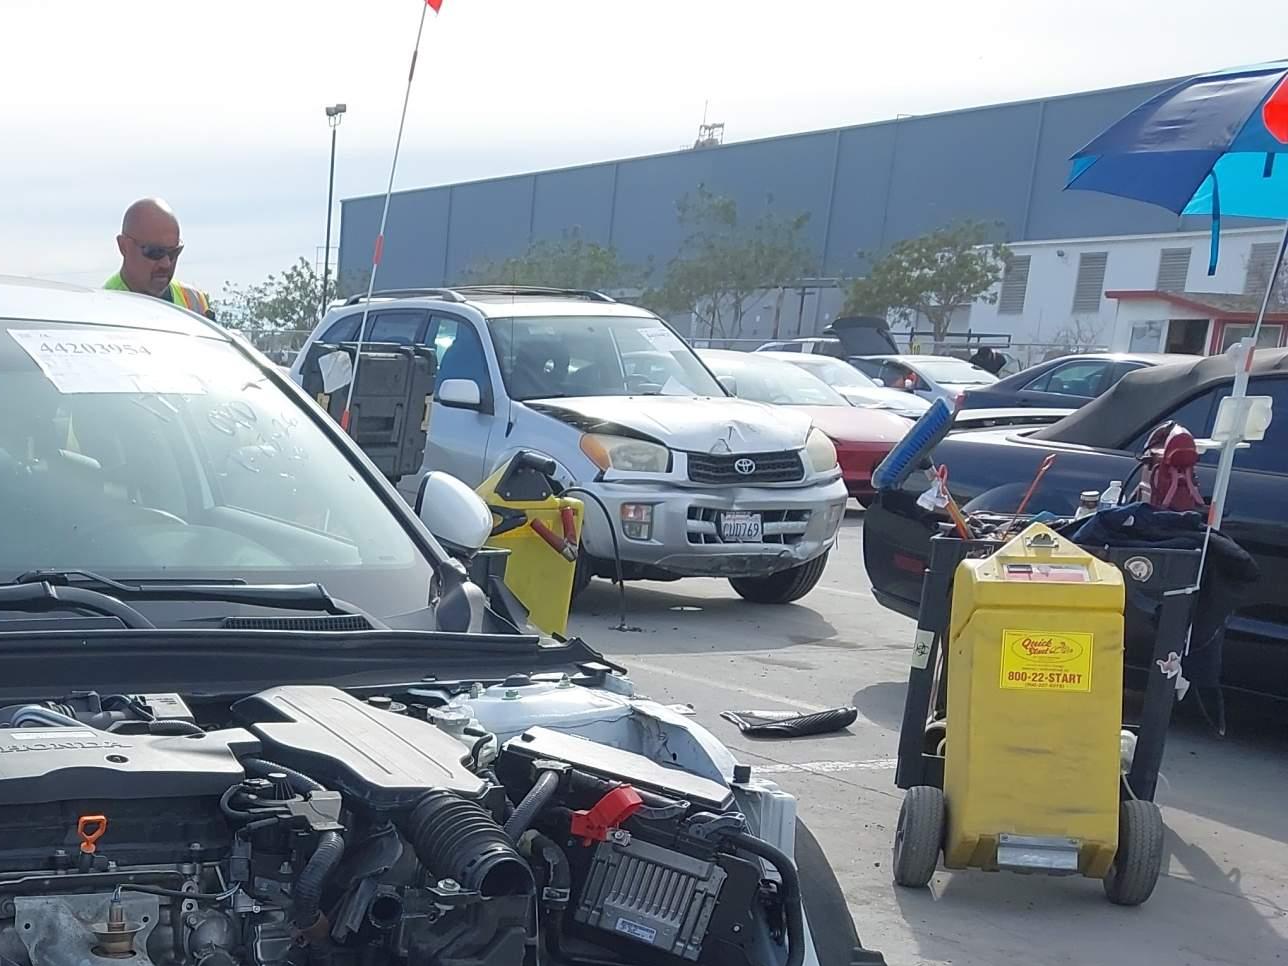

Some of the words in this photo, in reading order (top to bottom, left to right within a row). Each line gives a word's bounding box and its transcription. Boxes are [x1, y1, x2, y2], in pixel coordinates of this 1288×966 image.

[40, 342, 152, 356] 44203954
[1021, 638, 1053, 650] Quick
[1008, 671, 1082, 684] 800-22-START
